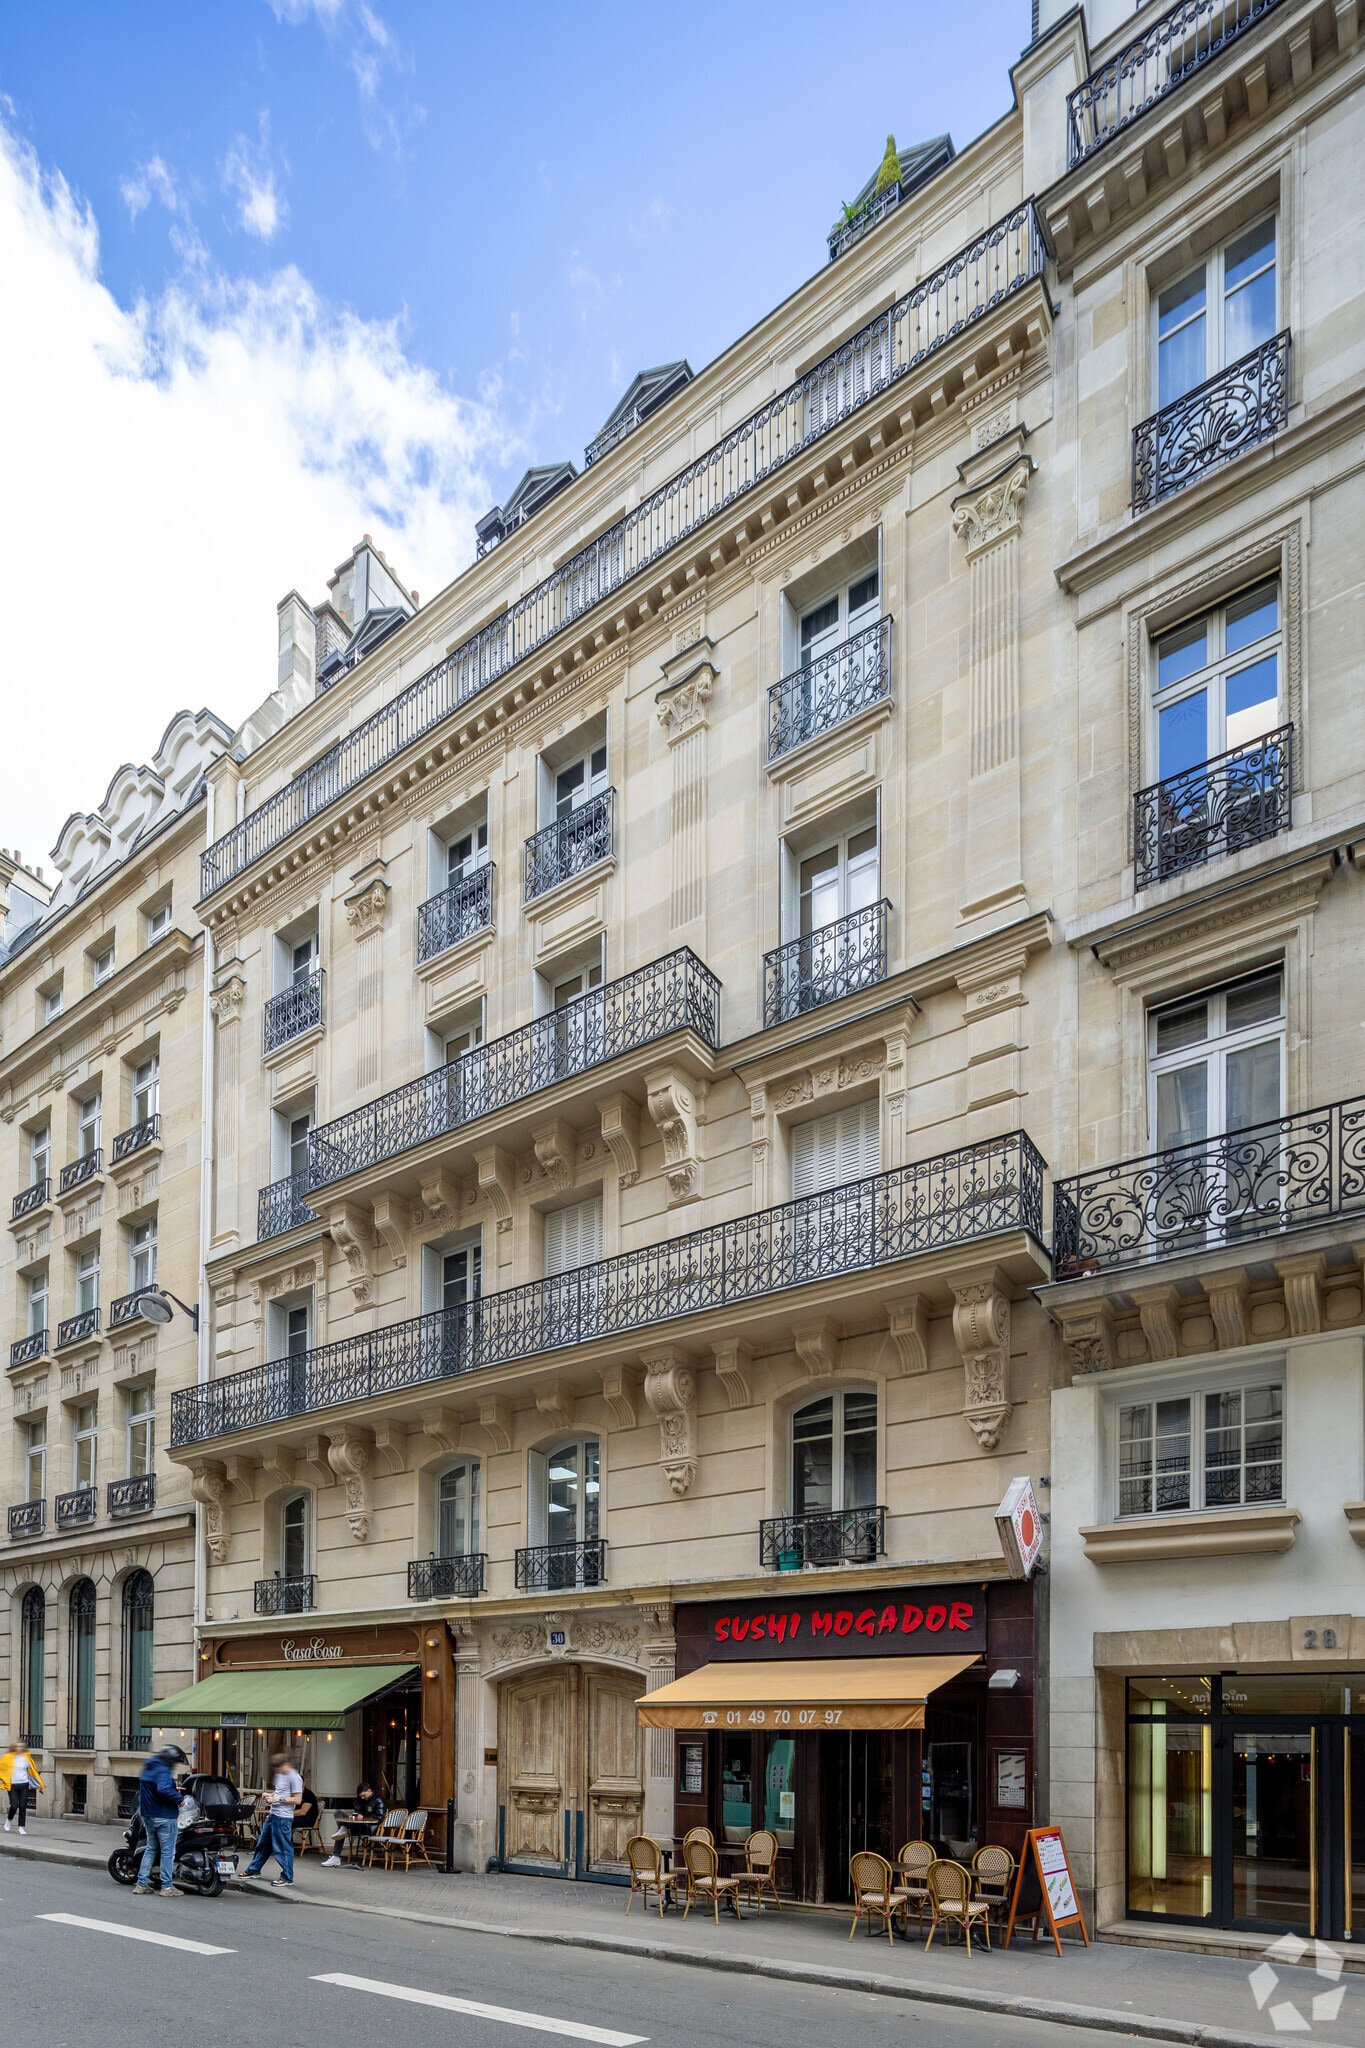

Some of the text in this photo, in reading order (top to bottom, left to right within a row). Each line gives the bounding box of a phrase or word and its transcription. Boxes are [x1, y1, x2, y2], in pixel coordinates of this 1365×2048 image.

[715, 1602, 973, 1643] SUSHI MOGADOR
[552, 1633, 564, 1644] 30
[1303, 1629, 1337, 1649] 28
[726, 1709, 843, 1724] 01 49 70 07 97
